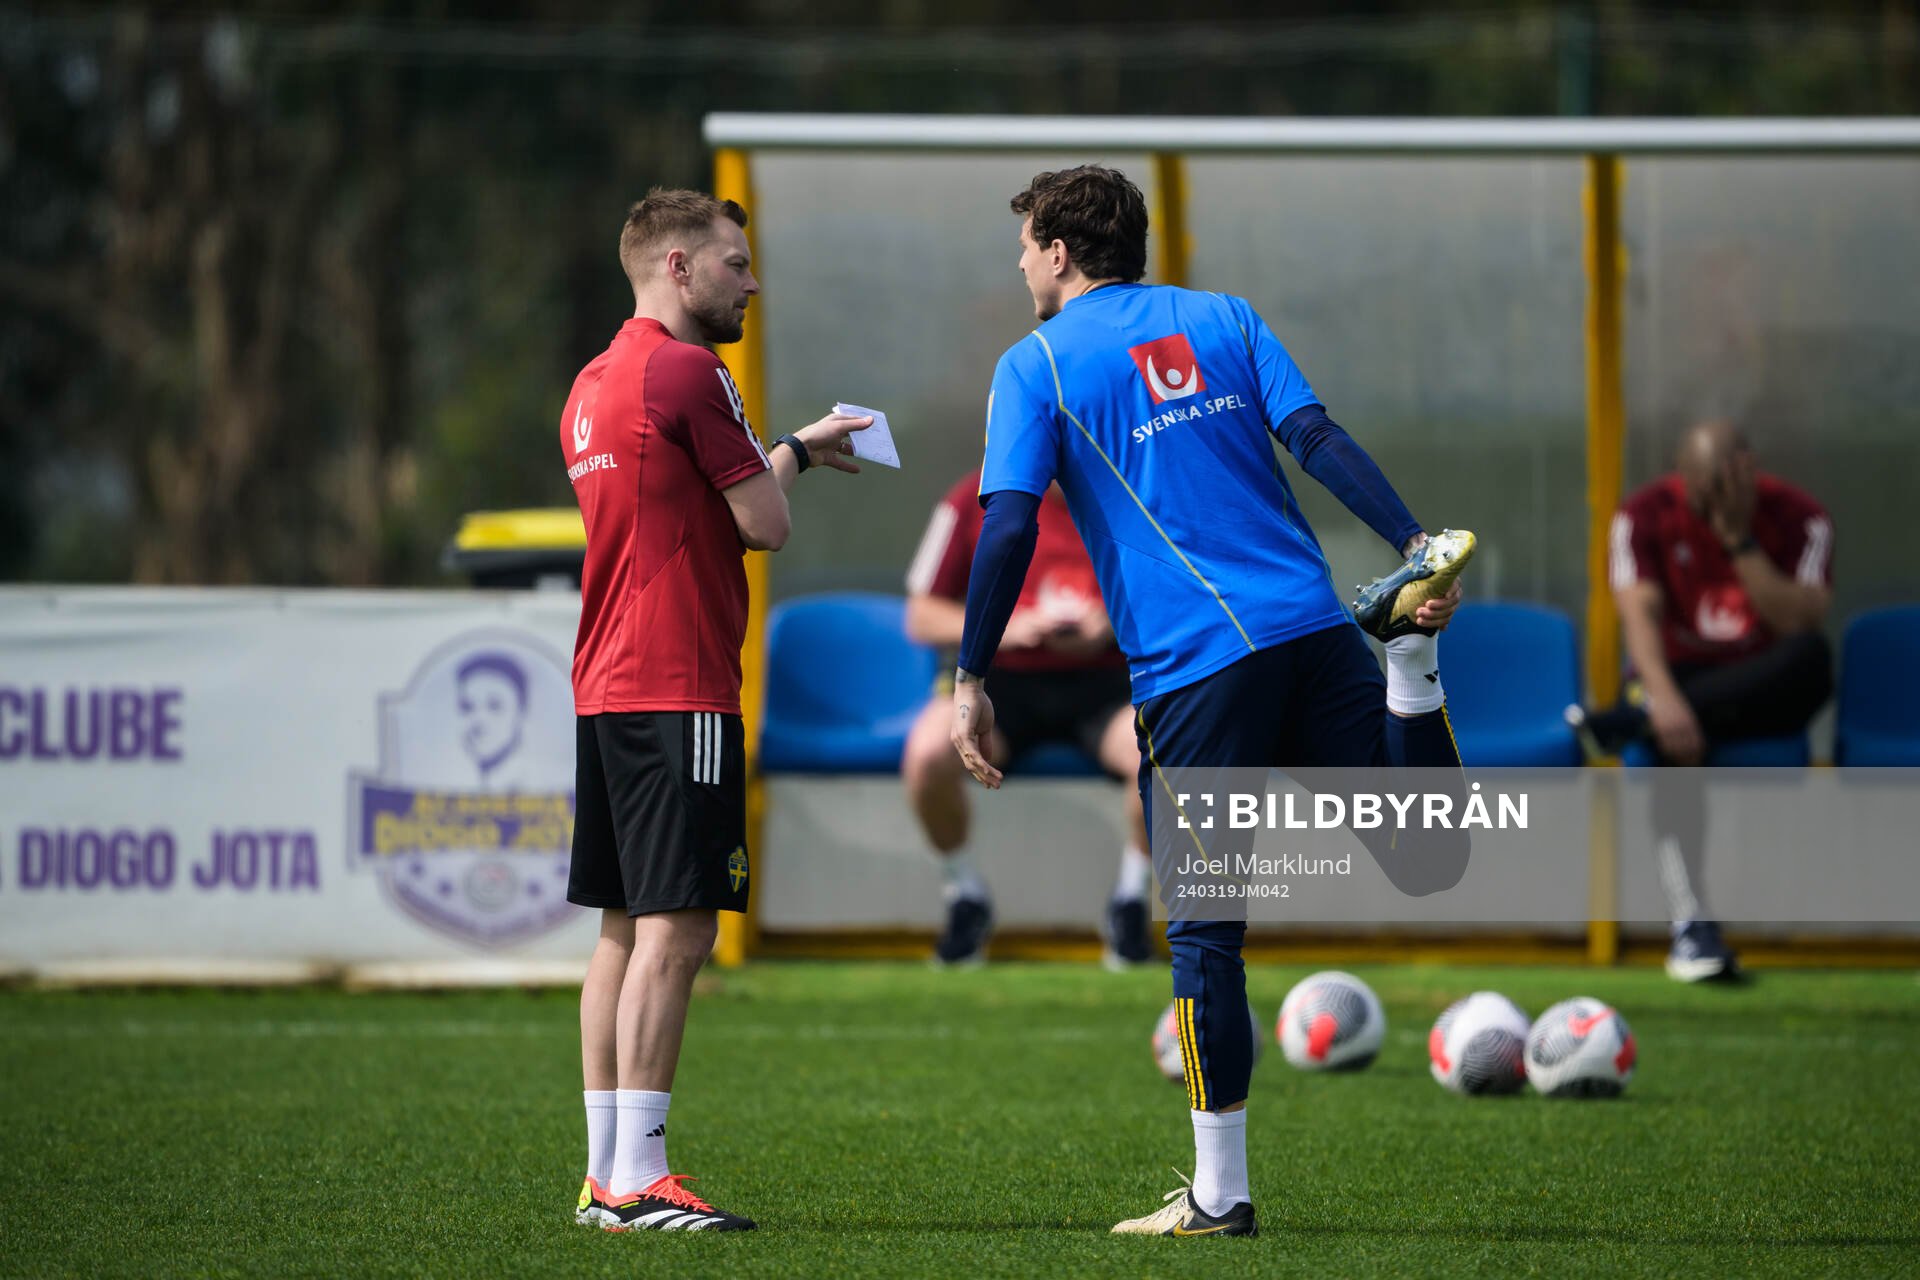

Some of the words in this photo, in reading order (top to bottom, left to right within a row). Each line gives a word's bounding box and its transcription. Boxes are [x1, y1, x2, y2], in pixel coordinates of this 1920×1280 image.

[1132, 405, 1203, 443] SVENSKA
[1205, 394, 1247, 415] SPEL
[588, 453, 618, 472] SPEL
[0, 687, 183, 762] CLUBE
[19, 828, 177, 889] DIOGO
[190, 829, 322, 892] JOTA
